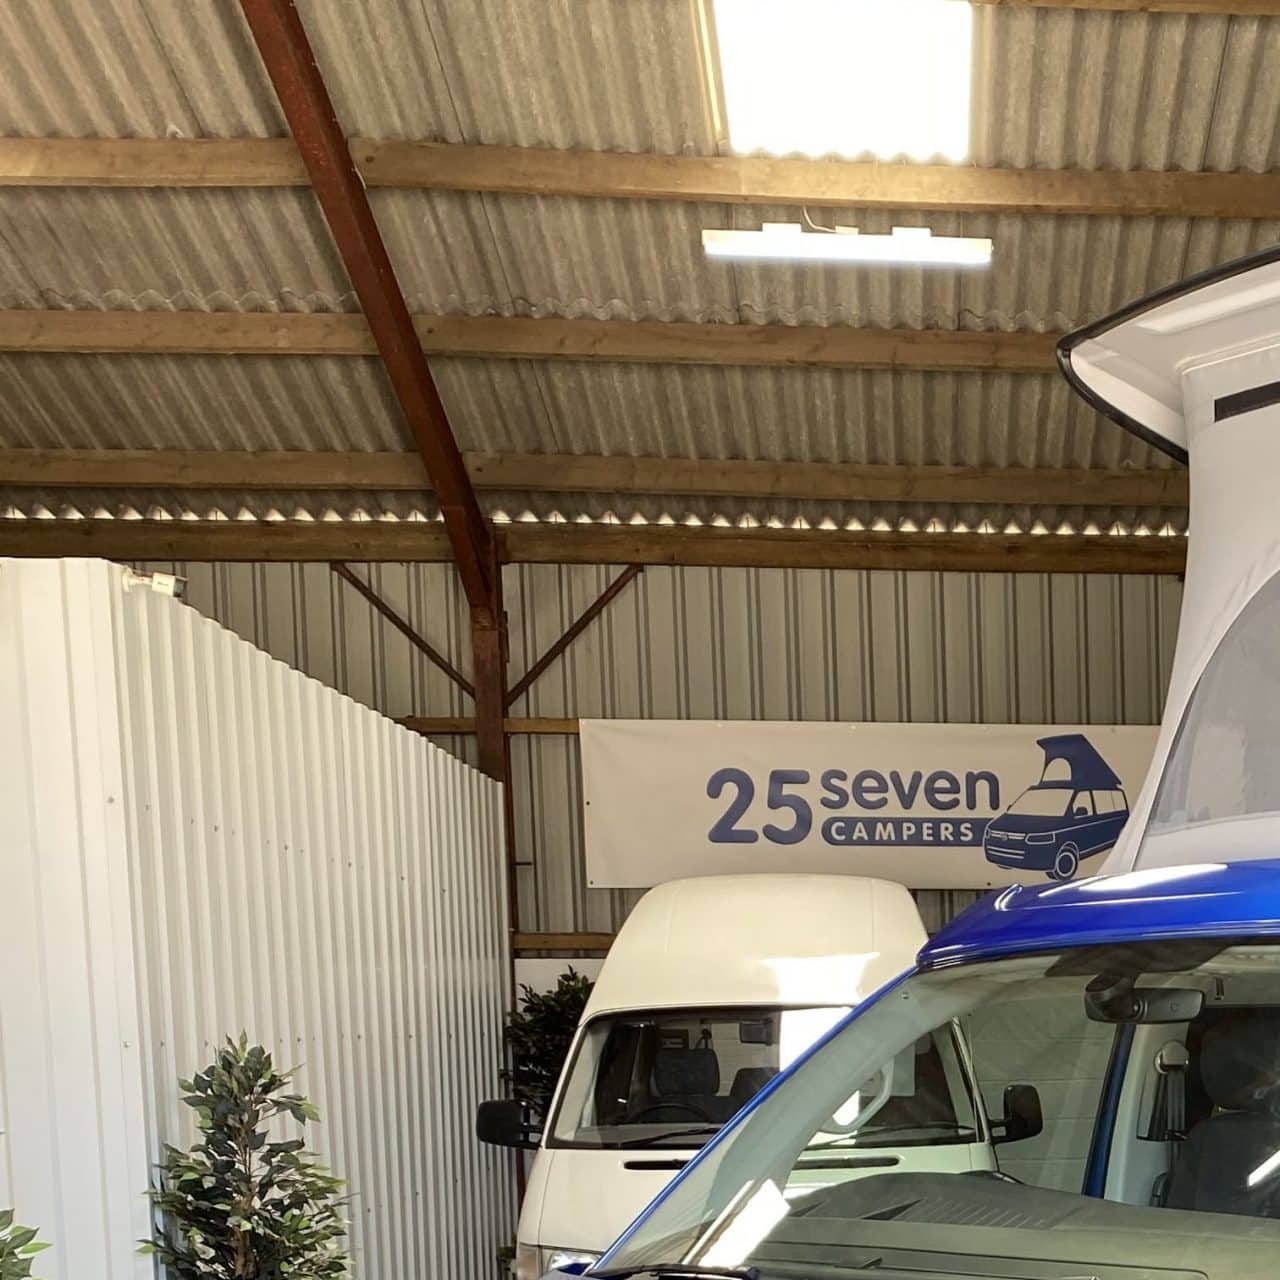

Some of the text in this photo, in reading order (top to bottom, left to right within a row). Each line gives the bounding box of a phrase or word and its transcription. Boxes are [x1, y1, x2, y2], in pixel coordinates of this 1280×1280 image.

[706, 767, 1000, 845] 25 seven
[830, 821, 974, 841] CAMPERS
